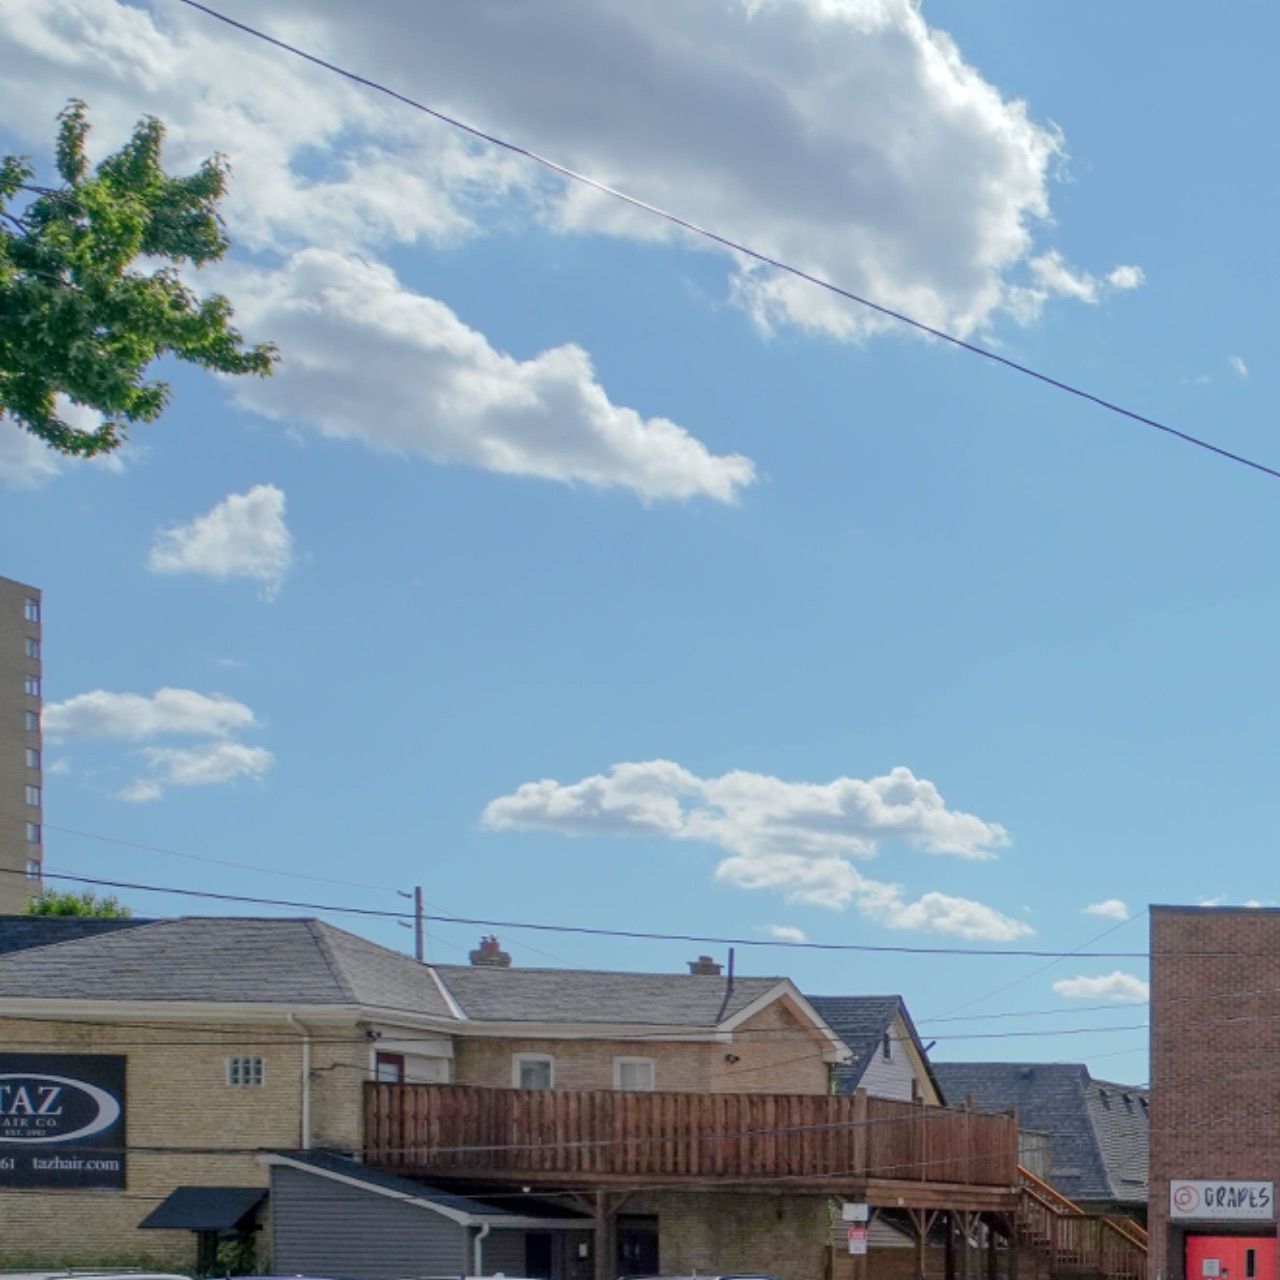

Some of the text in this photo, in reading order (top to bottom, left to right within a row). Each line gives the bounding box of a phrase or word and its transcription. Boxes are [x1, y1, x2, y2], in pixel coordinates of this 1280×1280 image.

[0, 1086, 63, 1115] TAZ
[32, 1155, 120, 1171] tazhair.com
[1204, 1186, 1270, 1208] GRAPES
